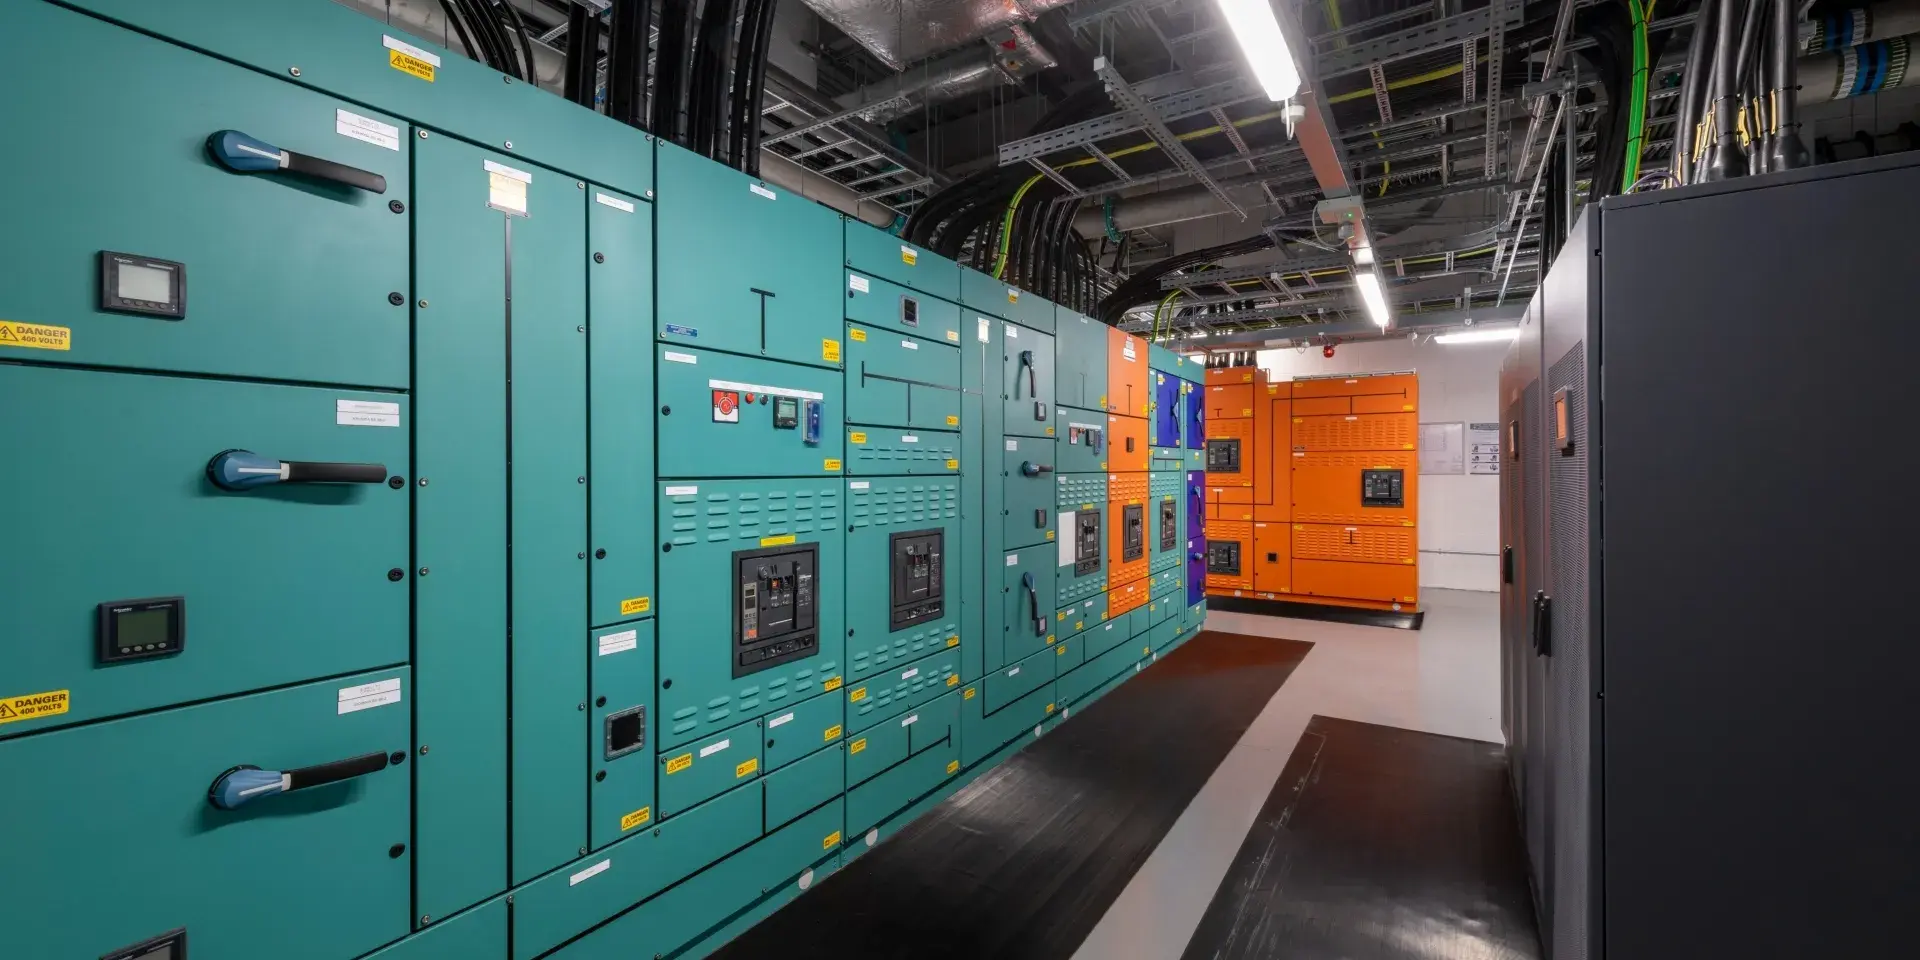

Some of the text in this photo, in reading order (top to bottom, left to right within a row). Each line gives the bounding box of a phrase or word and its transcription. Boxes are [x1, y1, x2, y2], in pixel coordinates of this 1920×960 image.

[405, 57, 433, 72] DANGER
[417, 68, 431, 78] VOLTS
[16, 326, 67, 338] DANGER
[39, 337, 63, 345] VOLTS
[15, 693, 66, 708] DANGER
[20, 703, 62, 715] 400 VOLTS
